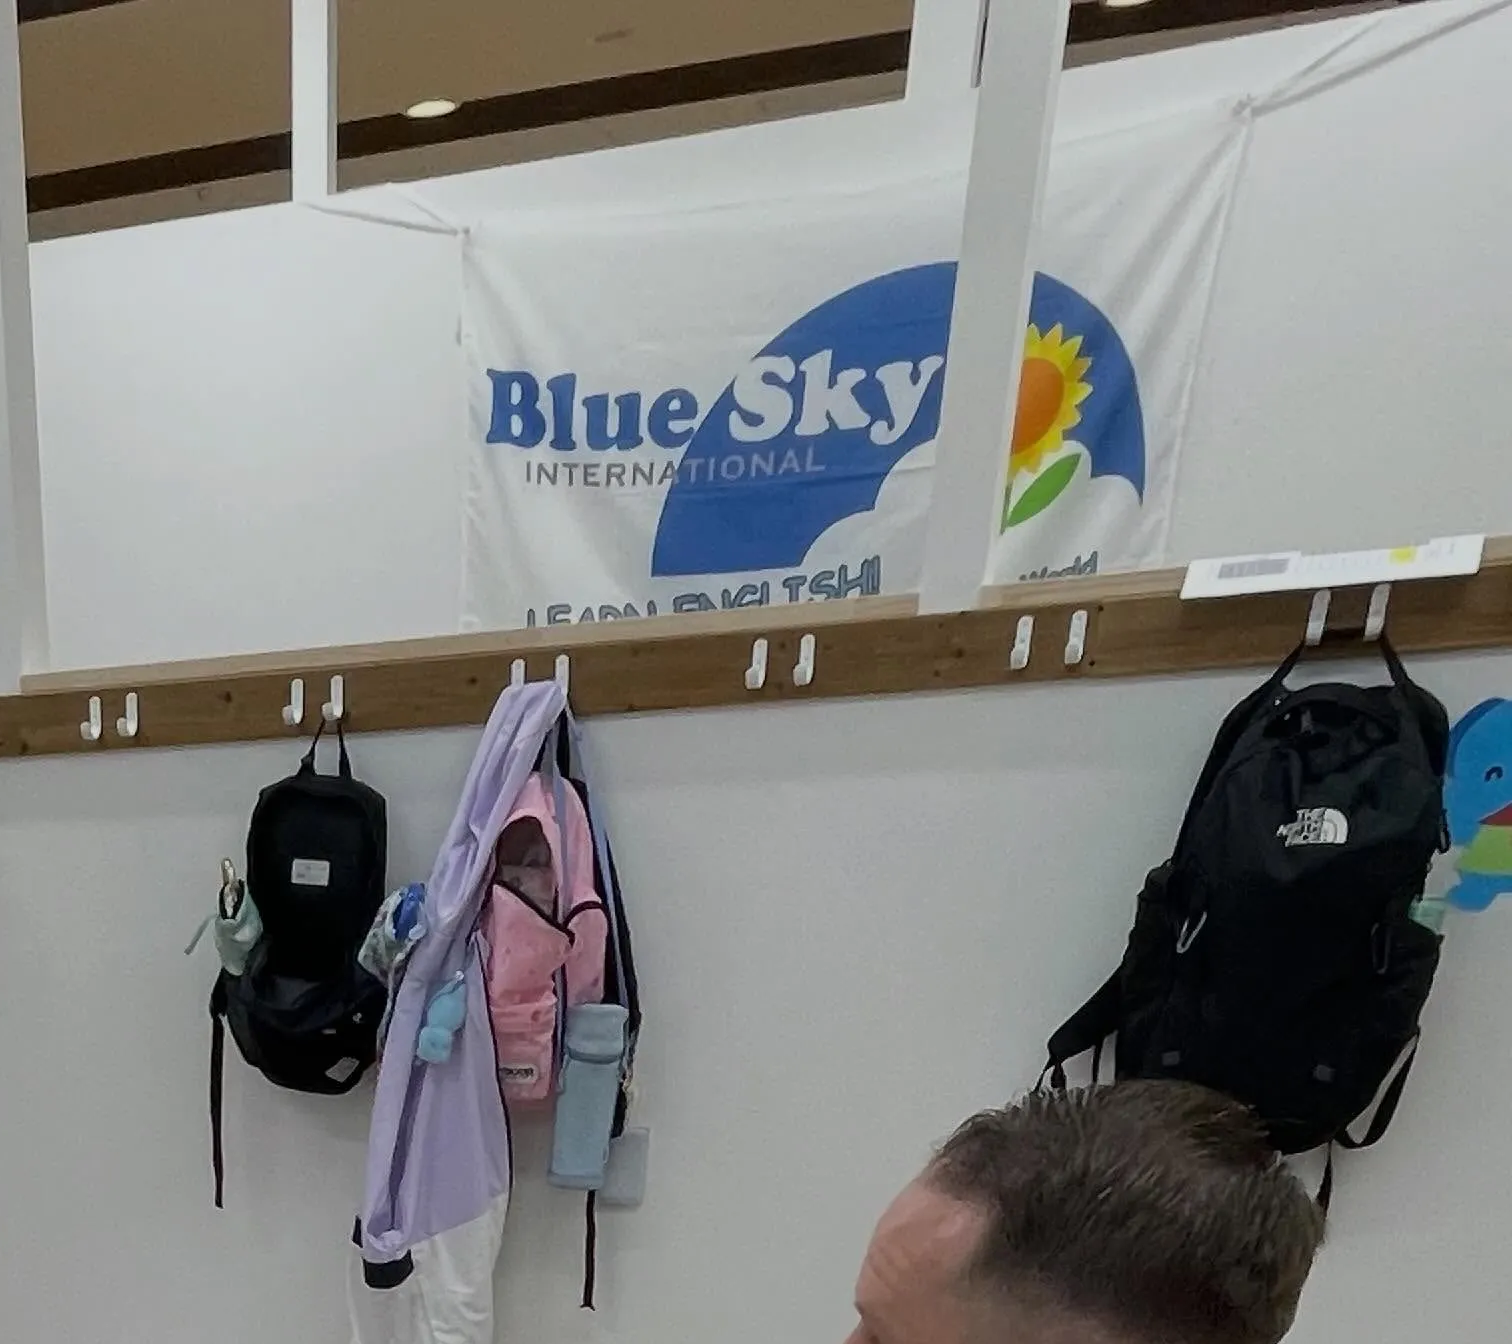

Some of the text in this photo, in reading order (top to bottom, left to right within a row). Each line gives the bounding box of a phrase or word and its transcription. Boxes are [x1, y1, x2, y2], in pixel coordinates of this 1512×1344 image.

[487, 348, 944, 451] Blue Sky
[526, 443, 826, 488] INTERNATIONAL
